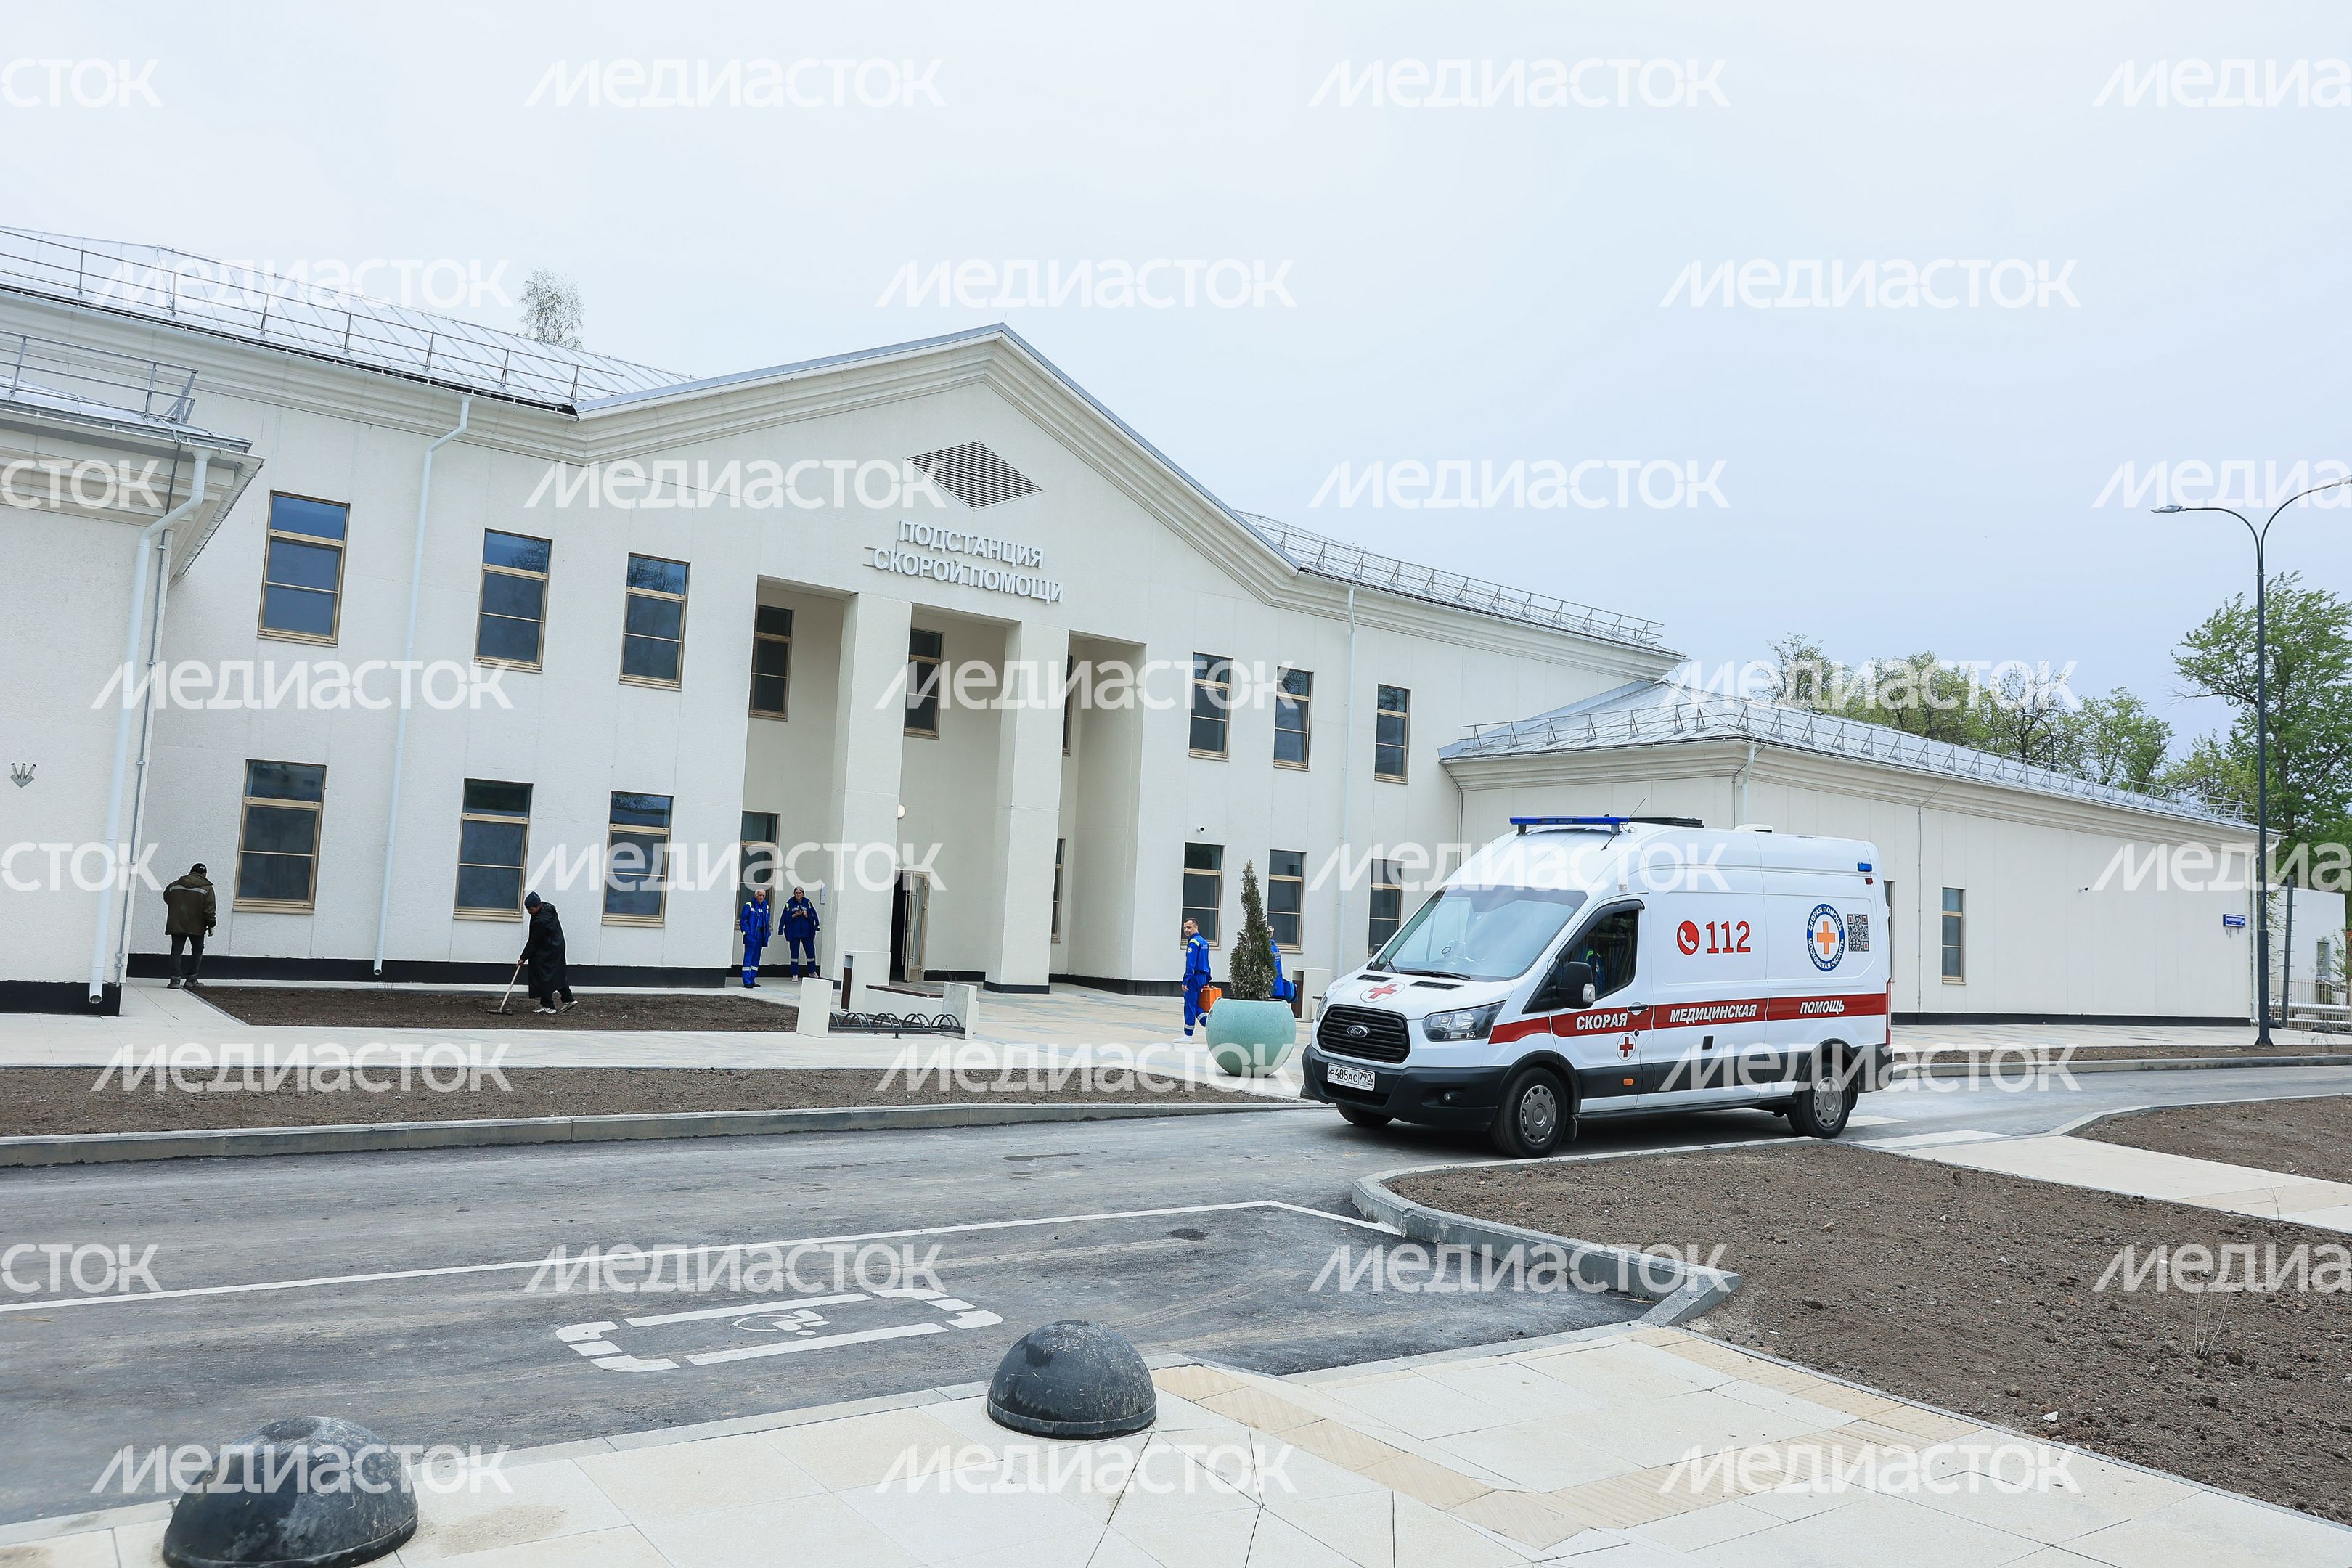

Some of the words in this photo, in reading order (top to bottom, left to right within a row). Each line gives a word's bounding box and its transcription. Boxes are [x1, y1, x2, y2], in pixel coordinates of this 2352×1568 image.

[898, 519, 1045, 569] ПОДСТАНЦИЯ
[873, 546, 964, 585] СКОРОЙ
[968, 564, 1064, 605] ПОМОЩИ
[1808, 907, 1823, 931] СКОРАЯ
[1823, 906, 1842, 931] ПОМОЩЬ
[1705, 920, 1752, 954] 112
[1808, 938, 1832, 969] МОСКОВСКАЯ
[1831, 939, 1844, 967] ОБЛАСТЬ
[1576, 1012, 1628, 1031] СКОРАЯ
[1670, 1003, 1757, 1024] МЕДИЦИНСКАЯ
[1800, 1000, 1845, 1014] ПОМОЩЬ
